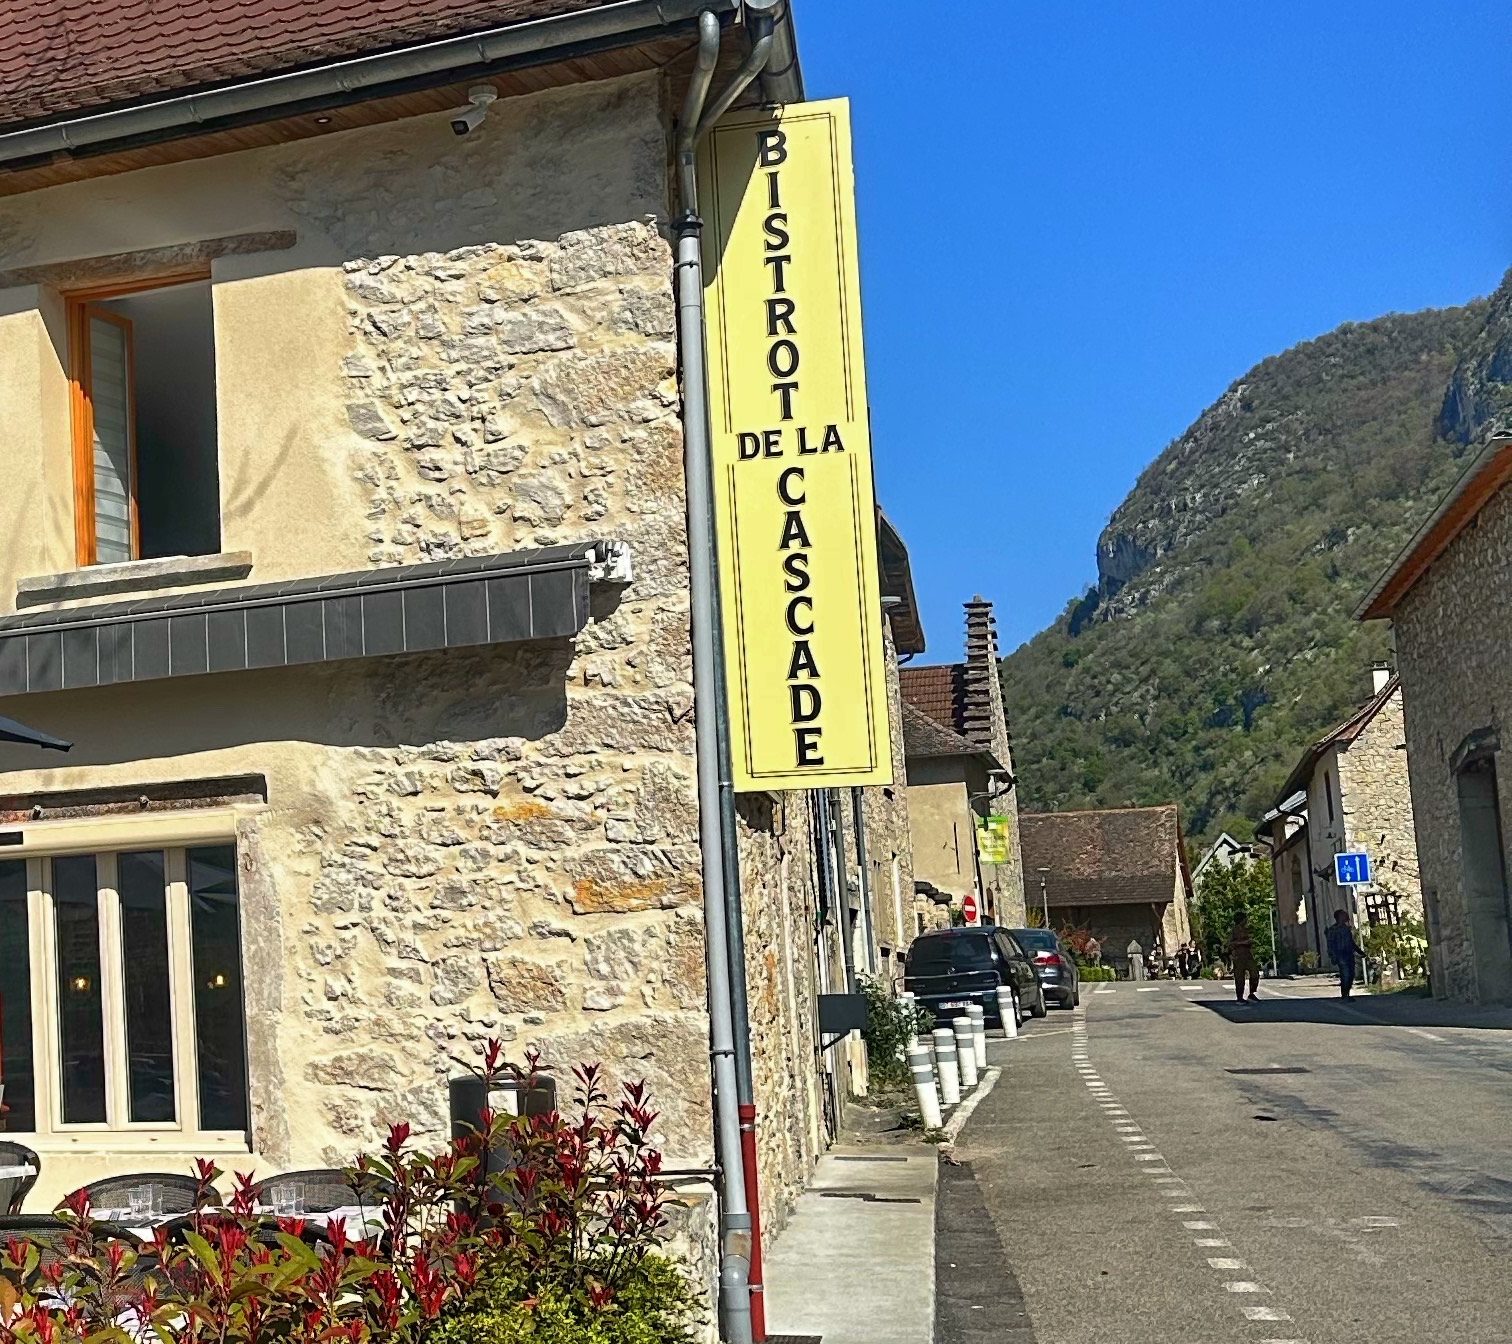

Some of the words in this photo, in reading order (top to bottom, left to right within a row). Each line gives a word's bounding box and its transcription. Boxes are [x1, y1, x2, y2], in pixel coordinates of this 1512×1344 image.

[756, 129, 799, 422] BISTROT
[736, 429, 784, 461] DE
[795, 424, 845, 456] LA
[777, 467, 825, 768] CASCADE
